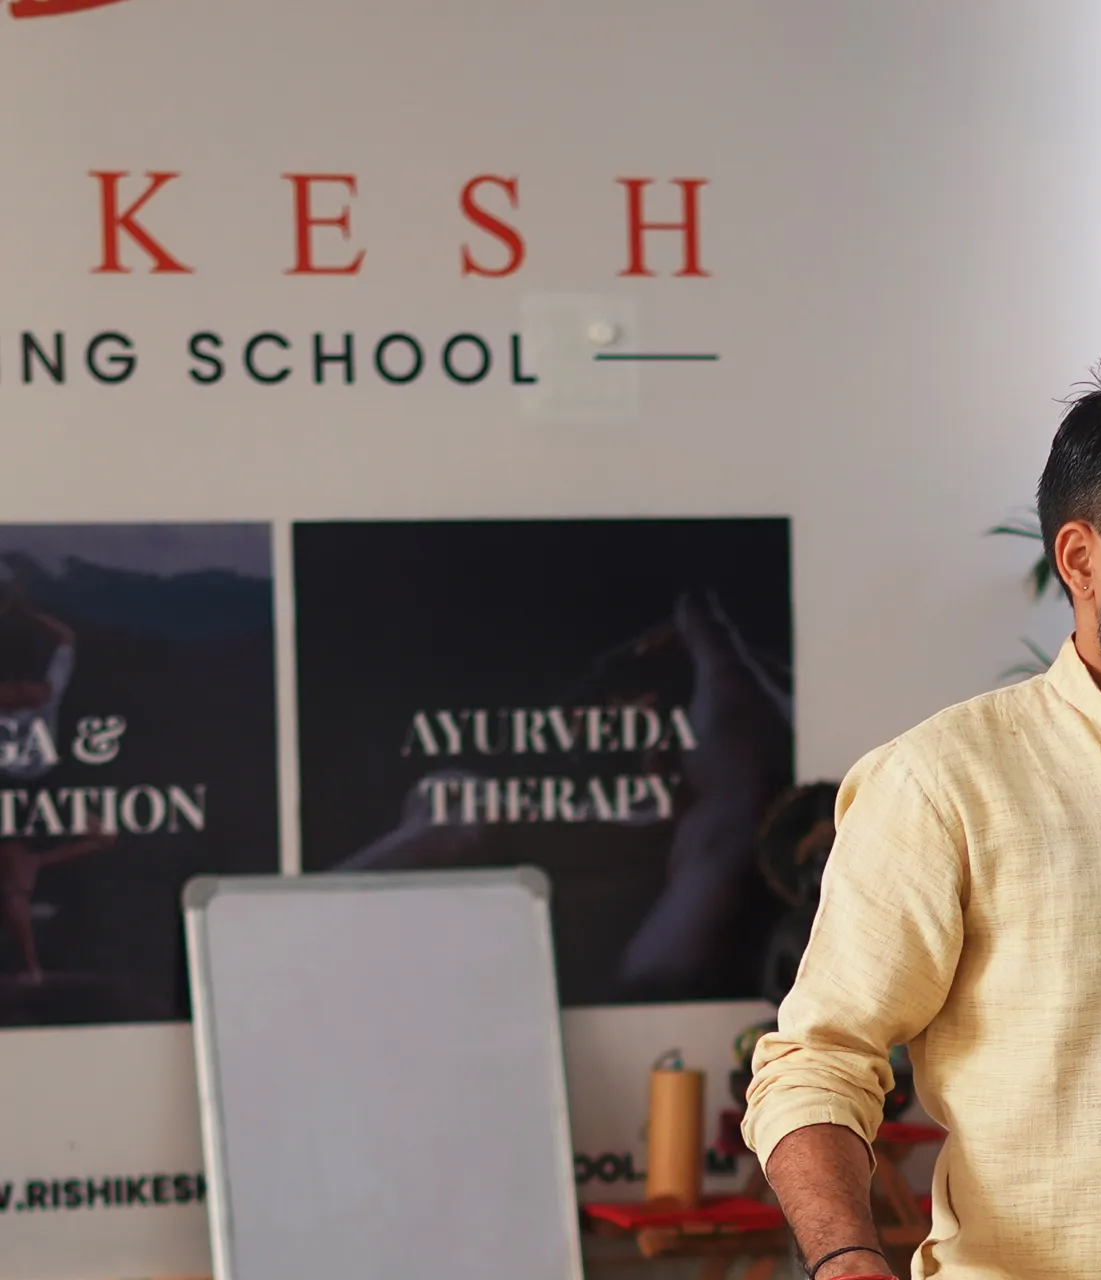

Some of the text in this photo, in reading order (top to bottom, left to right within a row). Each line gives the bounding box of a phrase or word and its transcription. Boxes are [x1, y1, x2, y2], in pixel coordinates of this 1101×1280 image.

[0, 330, 539, 385] NG SCHOOL
[72, 714, 127, 765] &
[401, 705, 698, 756] AYURVEDA
[0, 783, 207, 836] TATION
[418, 773, 681, 826] THERAPY
